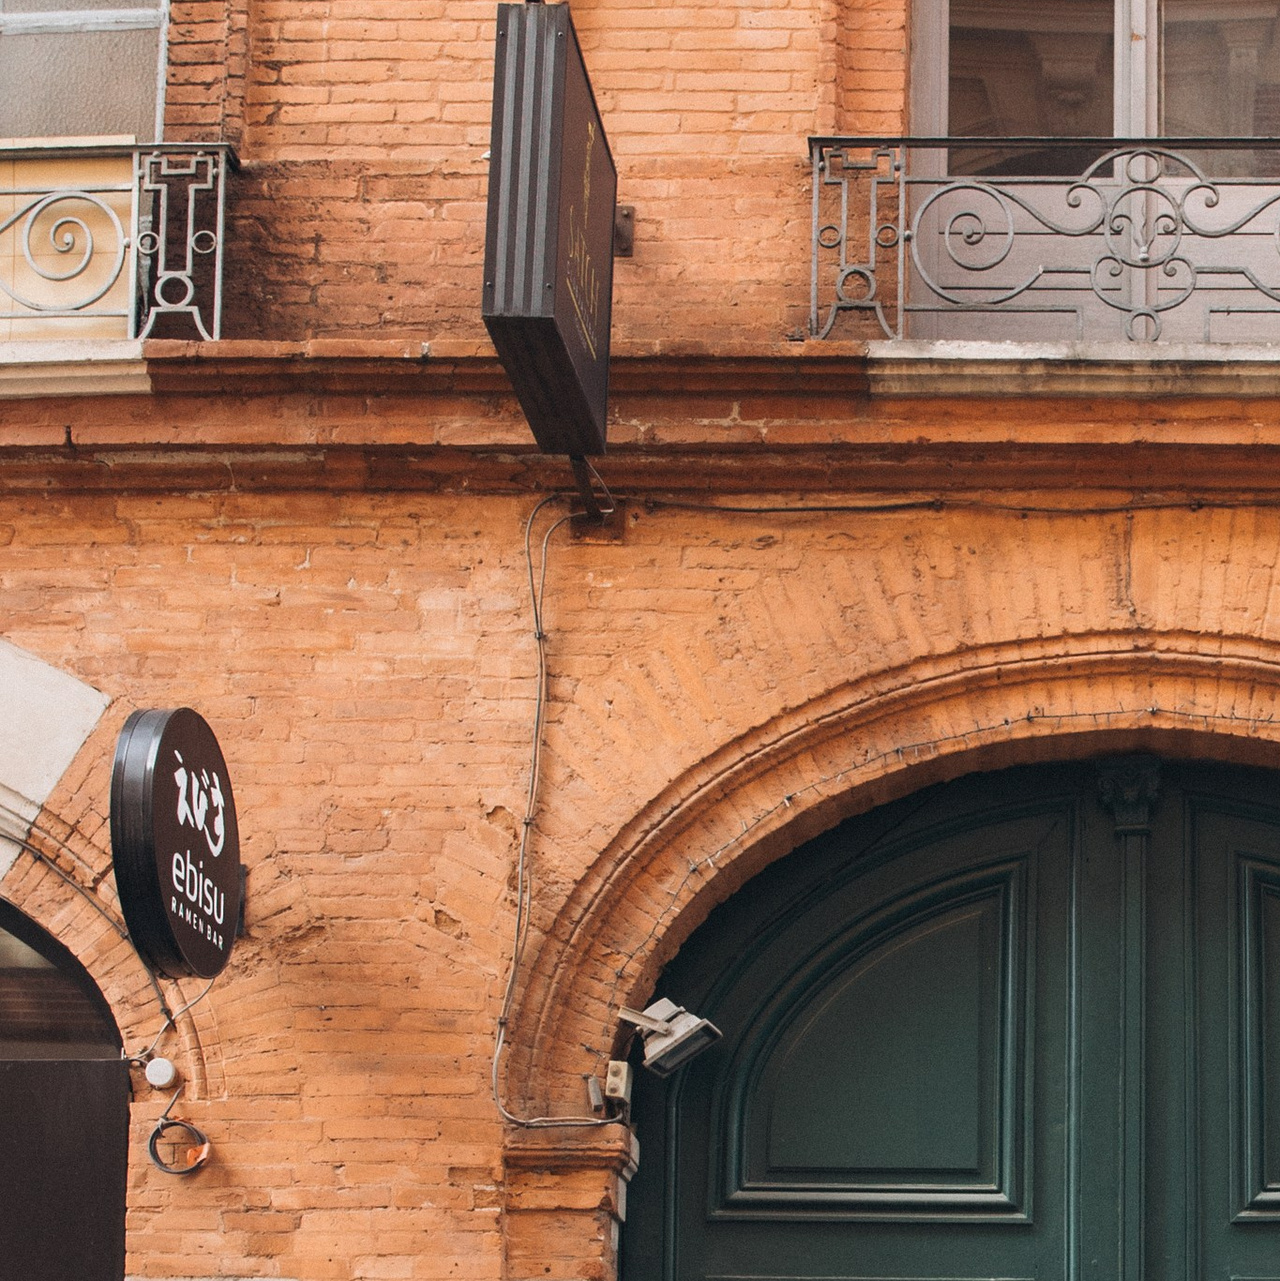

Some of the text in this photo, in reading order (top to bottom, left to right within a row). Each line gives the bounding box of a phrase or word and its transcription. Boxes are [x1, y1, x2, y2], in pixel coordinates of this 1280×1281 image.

[173, 749, 226, 857] えびす
[171, 849, 225, 925] ebisu
[171, 896, 224, 950] RAMEN BAR
